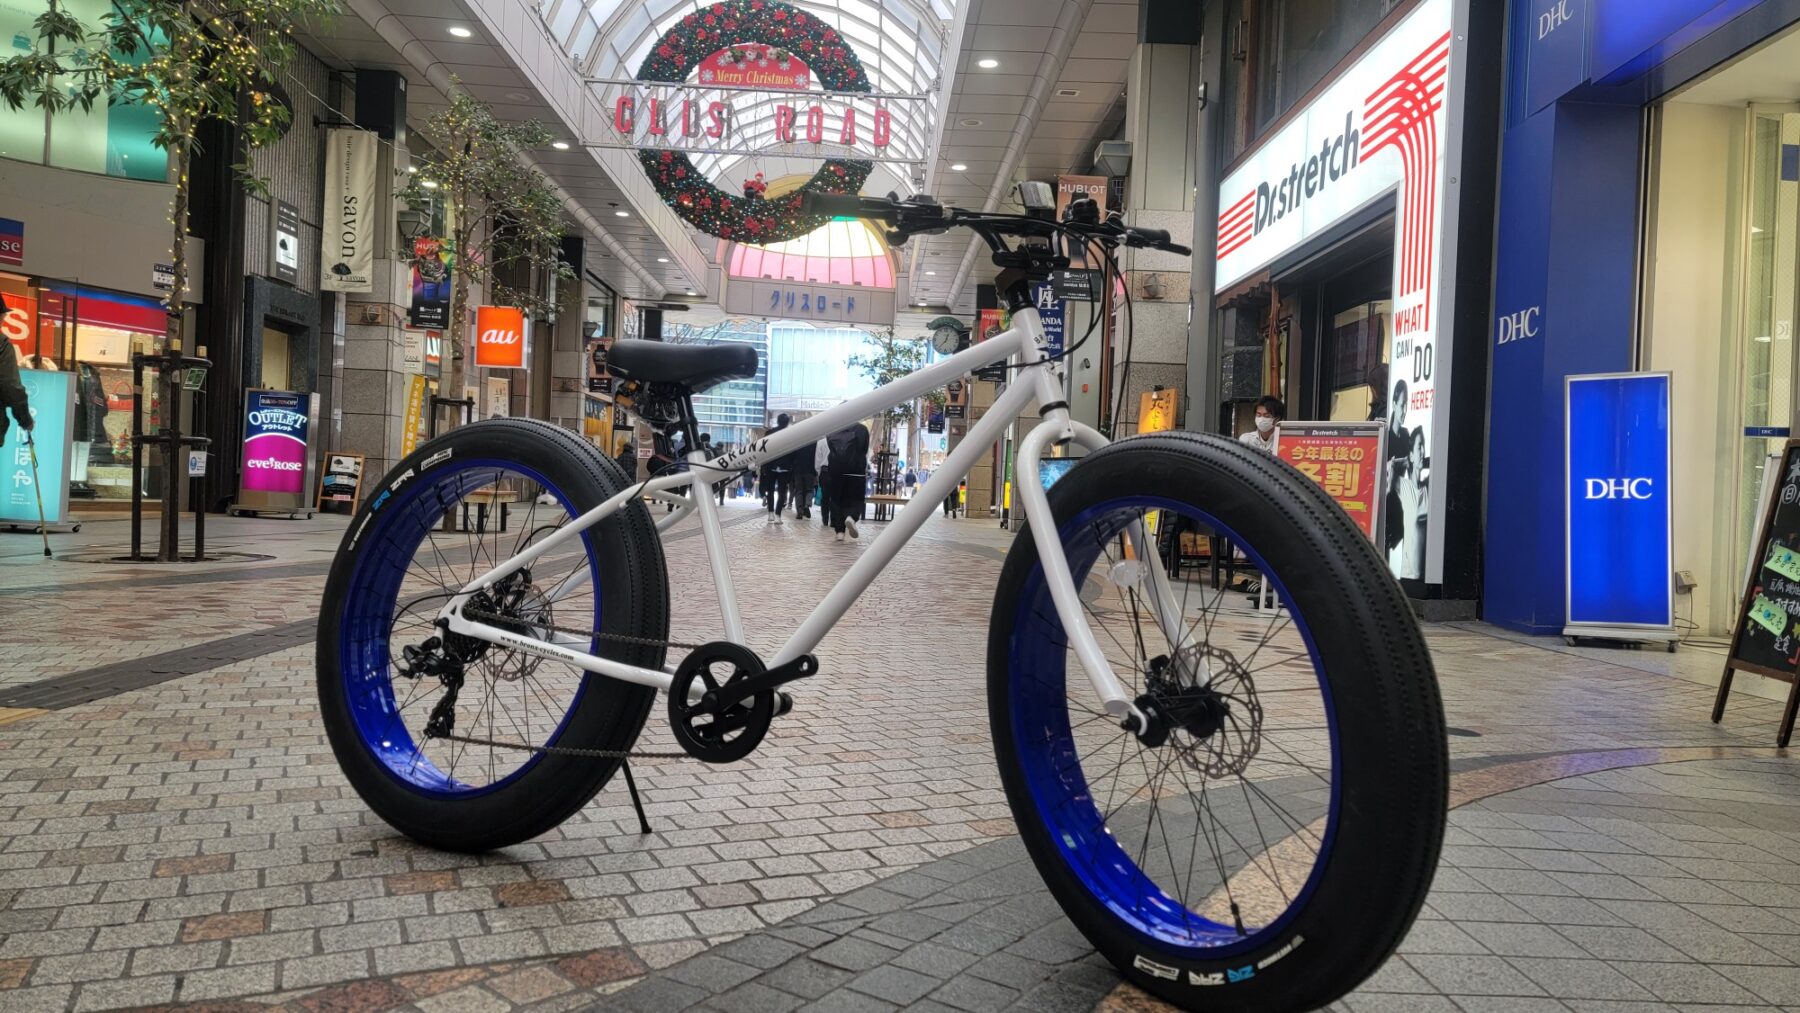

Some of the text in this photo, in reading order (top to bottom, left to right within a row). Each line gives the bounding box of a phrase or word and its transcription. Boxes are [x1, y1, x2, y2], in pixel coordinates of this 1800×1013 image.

[1539, 0, 1574, 40] DHC
[715, 69, 794, 85] Merry Christmas
[775, 104, 891, 147] ROAD
[1254, 110, 1359, 237] Dr.stretch
[1059, 184, 1106, 194] HUBLOT
[342, 195, 358, 258] savon
[771, 290, 855, 315] クリスロード
[1395, 304, 1423, 337] WHAT
[1498, 306, 1540, 345] DHC
[481, 329, 520, 344] au
[1413, 343, 1433, 383] DO
[1411, 389, 1435, 411] HERE?
[248, 411, 307, 429] OUTLET
[262, 424, 293, 432] アウトレット
[717, 439, 768, 469] BRONX
[1291, 446, 1364, 461] 今年最後の
[1585, 477, 1653, 500] DHC
[500, 635, 574, 661] www.bronx-cycles.com
[1188, 965, 1255, 986] ZIG ZAG
